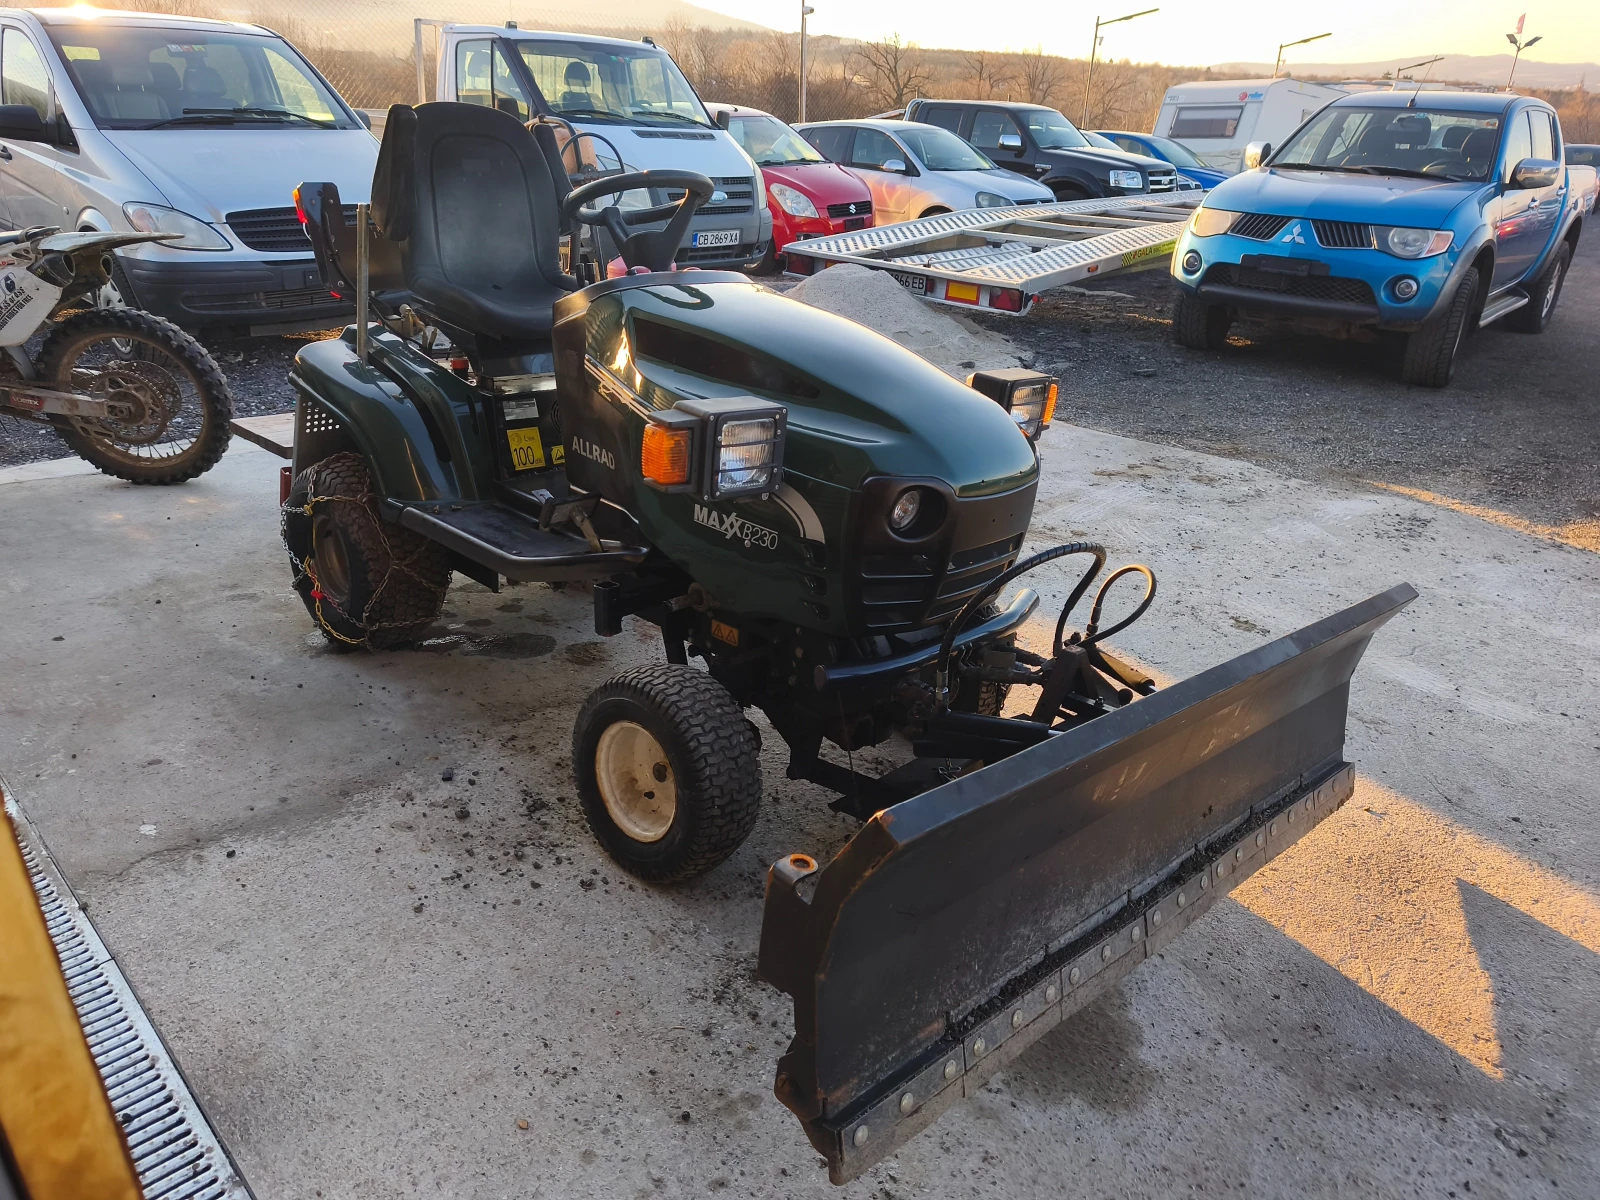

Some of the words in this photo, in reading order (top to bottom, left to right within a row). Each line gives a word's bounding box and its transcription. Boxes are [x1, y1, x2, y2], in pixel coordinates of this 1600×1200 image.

[698, 234, 709, 246] CB
[710, 233, 729, 245] 2869
[911, 276, 925, 290] EB
[513, 446, 535, 467] 100
[572, 435, 616, 470] ALLRAD
